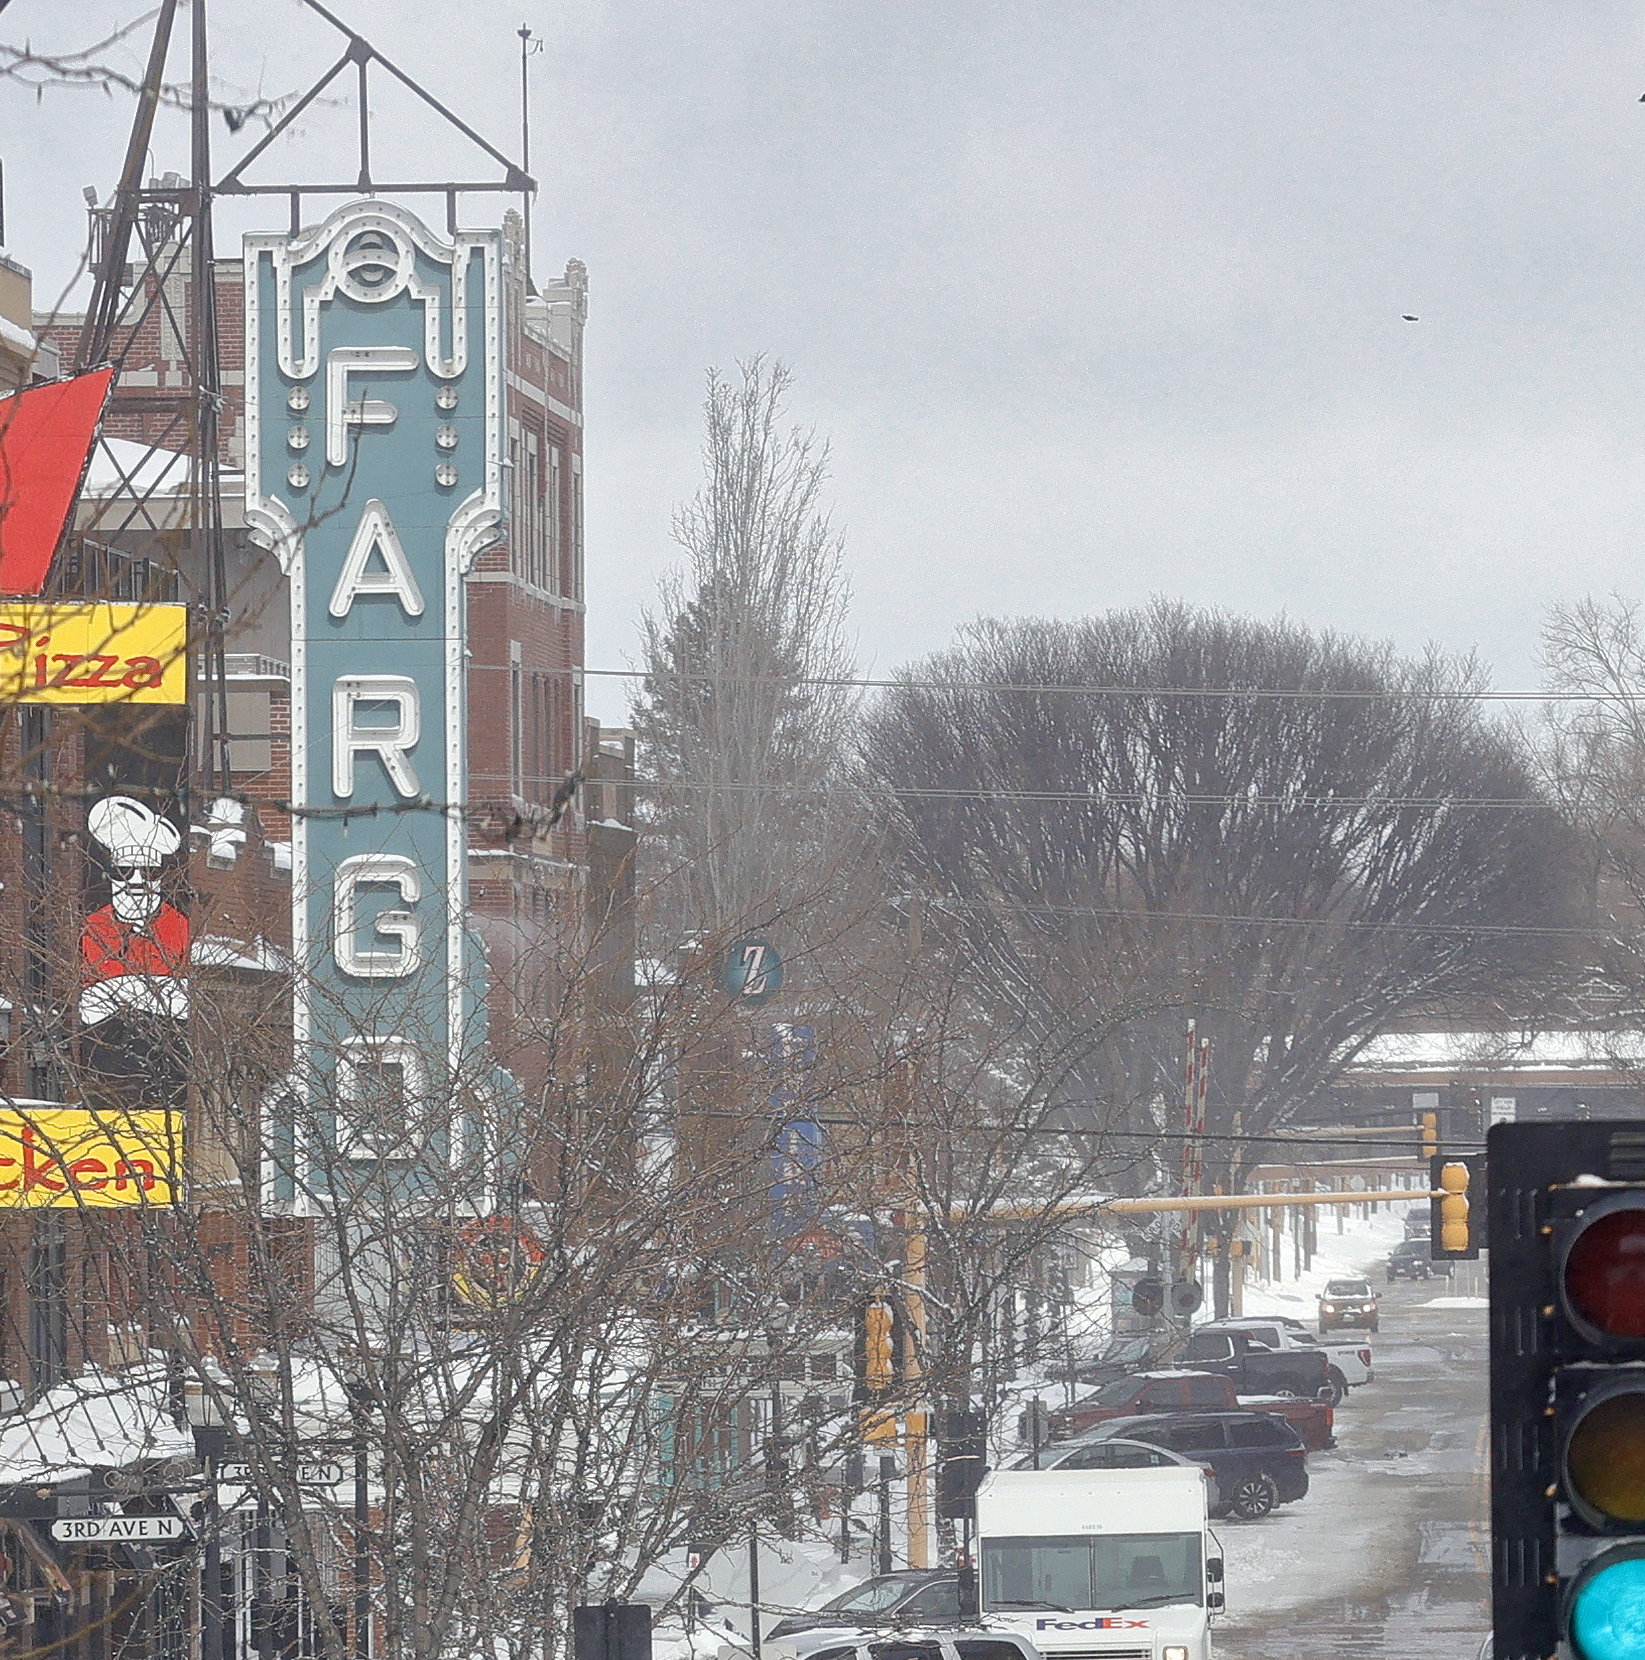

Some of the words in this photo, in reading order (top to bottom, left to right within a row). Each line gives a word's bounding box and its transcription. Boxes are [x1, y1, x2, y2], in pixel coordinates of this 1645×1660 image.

[325, 346, 426, 1160] FARGO
[743, 946, 766, 993] Z
[62, 1521, 100, 1538] 3RD
[109, 1519, 148, 1537] AVE
[158, 1518, 172, 1535] N
[1036, 1617, 1150, 1631] FedEx
